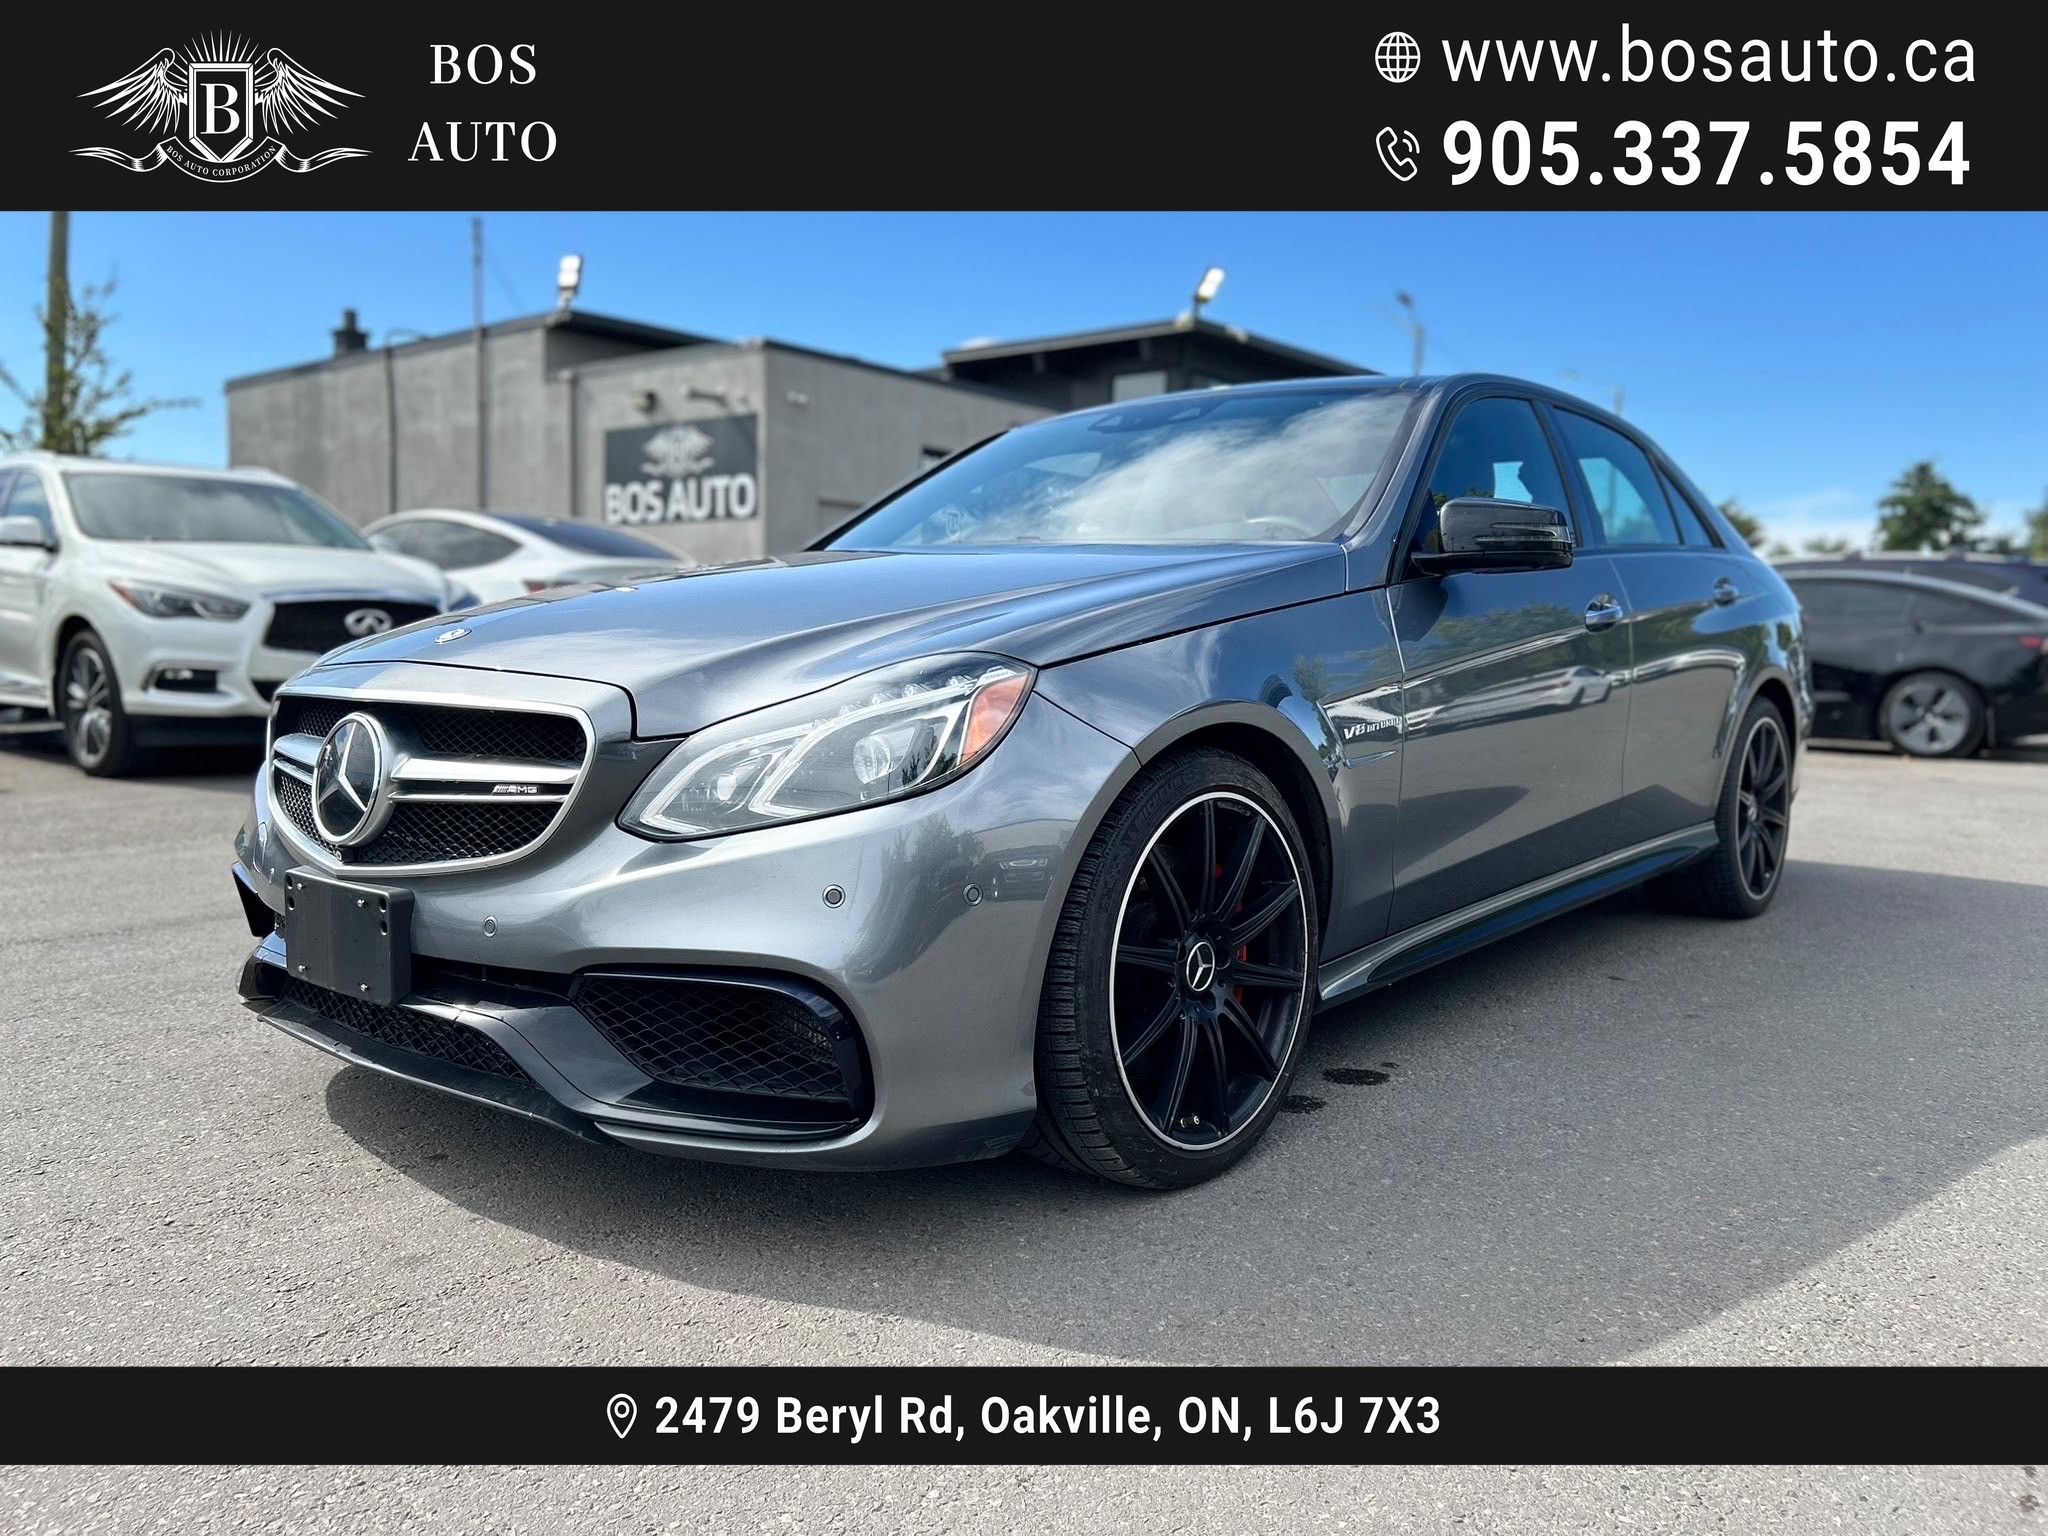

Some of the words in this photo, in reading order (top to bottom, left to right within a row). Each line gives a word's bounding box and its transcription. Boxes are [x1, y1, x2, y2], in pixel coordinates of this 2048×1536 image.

[605, 481, 665, 525] BOS
[666, 473, 757, 521] AUTO
[1343, 722, 1366, 740] V8
[506, 785, 538, 794] AMG
